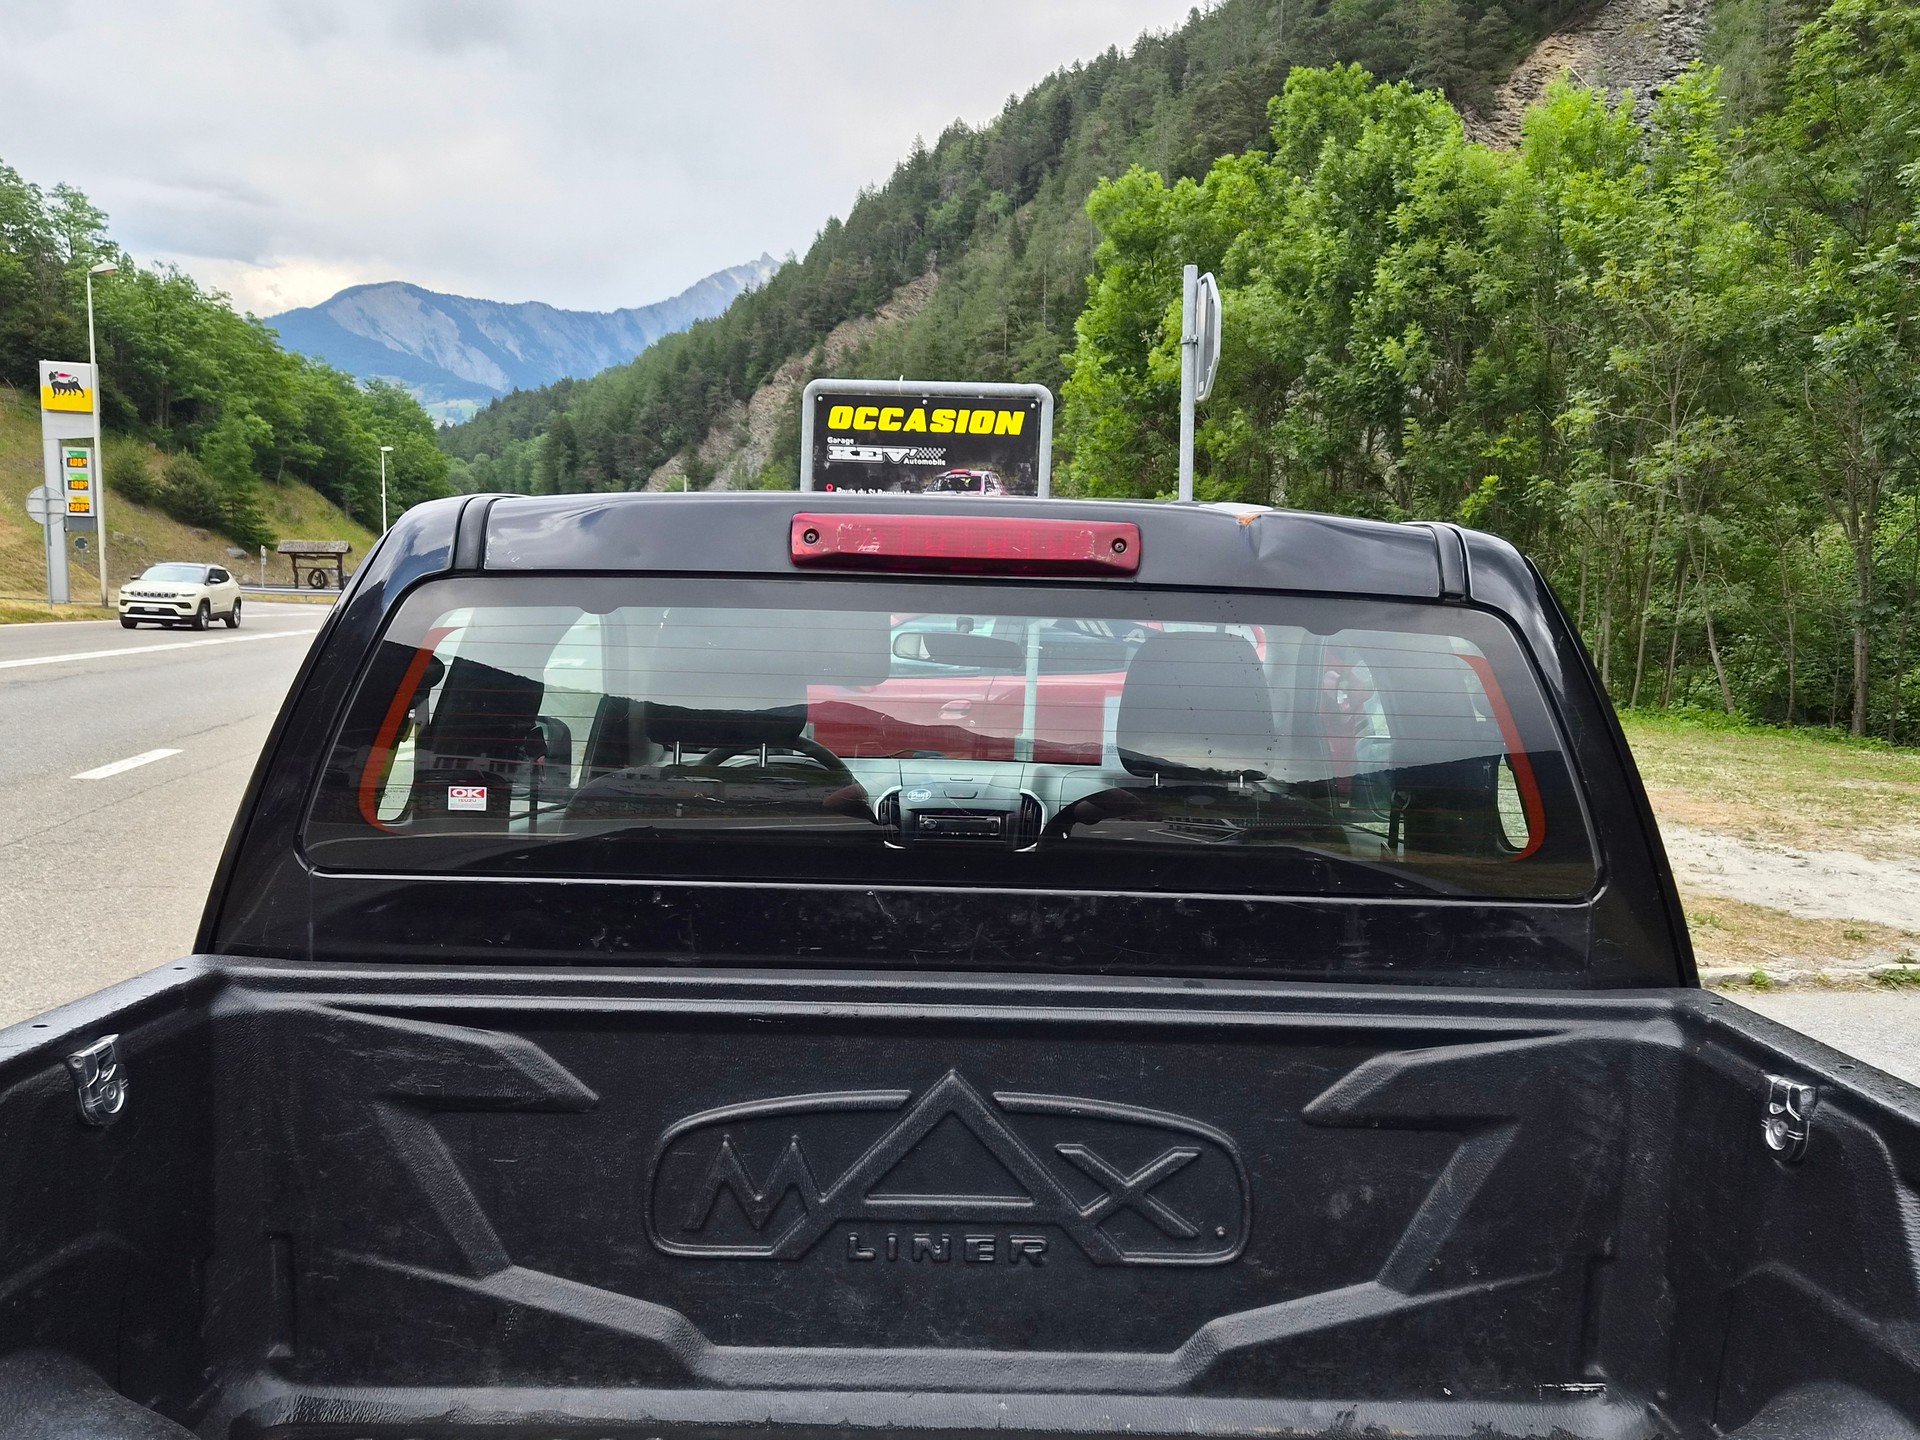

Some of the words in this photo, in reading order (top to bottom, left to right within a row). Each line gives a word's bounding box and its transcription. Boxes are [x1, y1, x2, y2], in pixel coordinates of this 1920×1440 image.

[827, 405, 1026, 436] OCCASION
[827, 437, 854, 445] Garage
[903, 458, 946, 466] Automobile
[451, 788, 484, 798] OK
[683, 1068, 1202, 1262] MAX
[846, 1231, 1051, 1268] LINER
